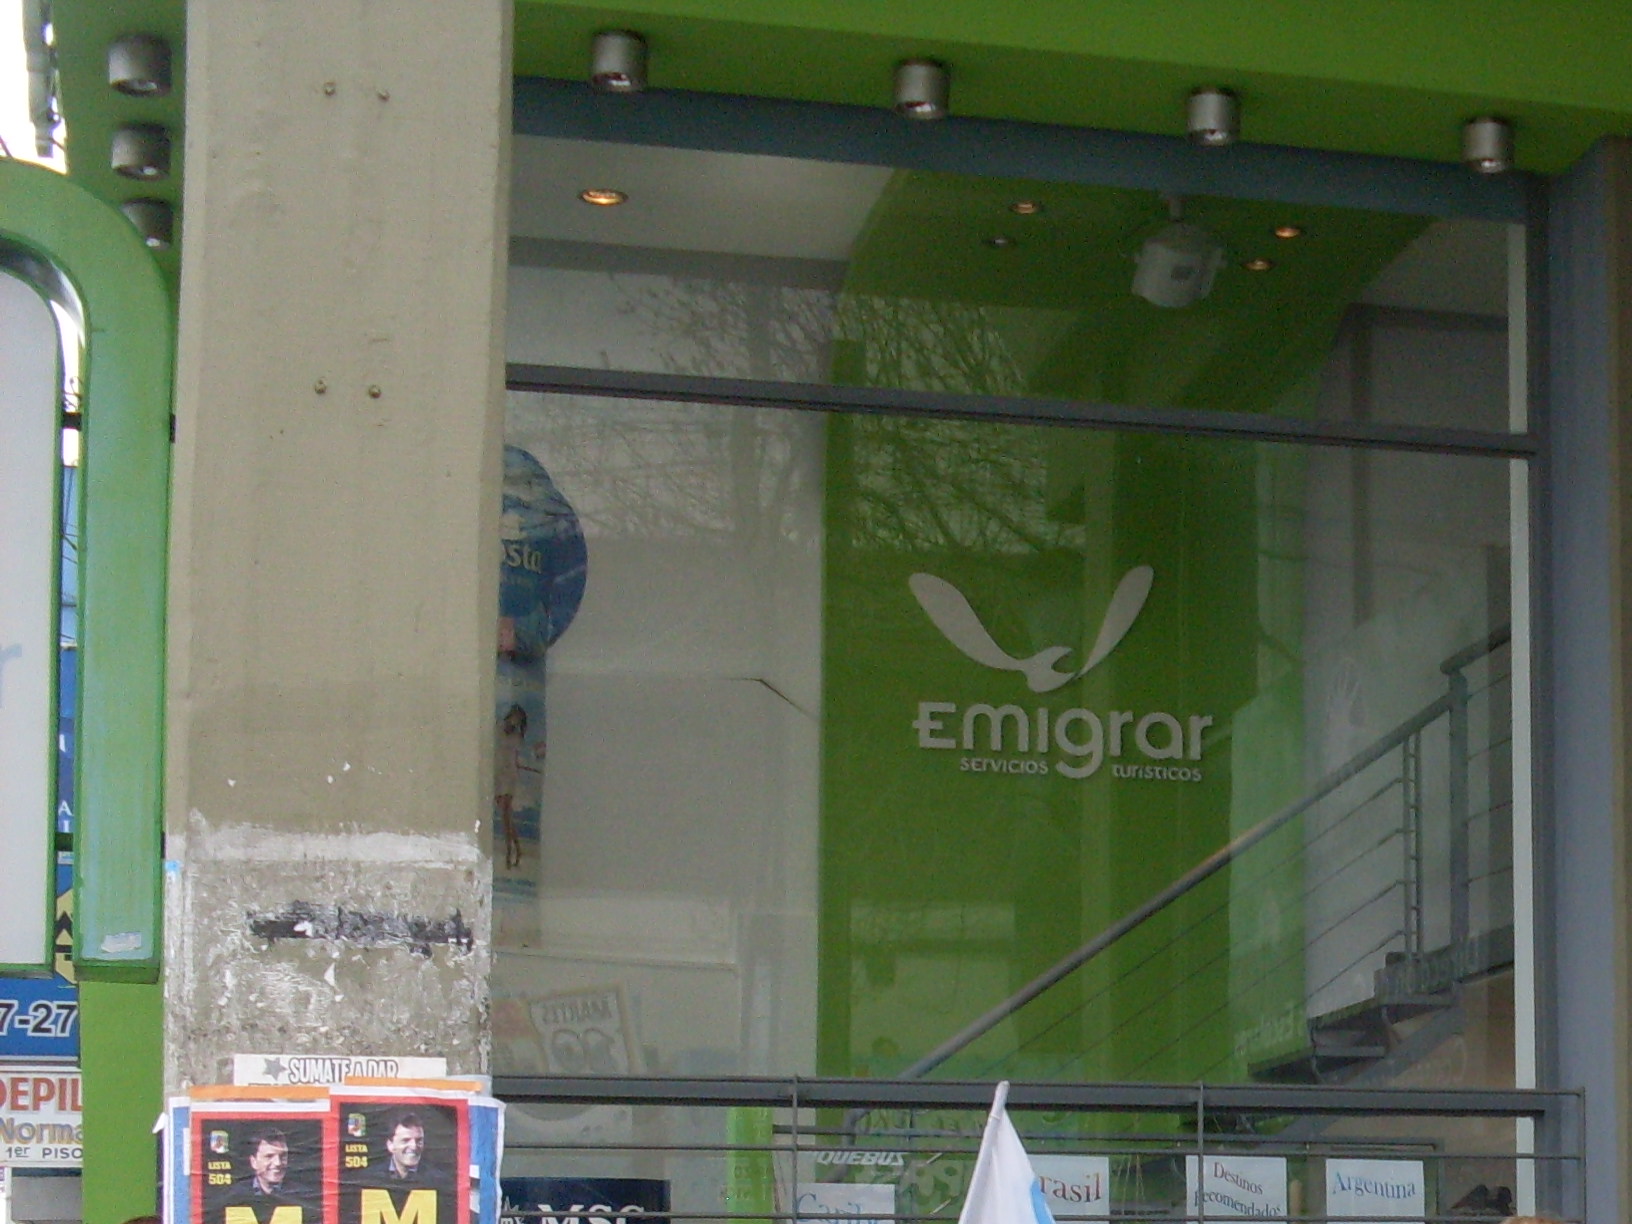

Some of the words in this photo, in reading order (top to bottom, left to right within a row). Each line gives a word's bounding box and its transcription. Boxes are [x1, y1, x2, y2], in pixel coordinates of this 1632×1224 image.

[912, 702, 1213, 779] Emigrar
[288, 1058, 350, 1085] SUMATE
[368, 1059, 399, 1079] DAR
[345, 1144, 368, 1153] LISTA
[345, 1156, 368, 1168] 504
[208, 1161, 231, 1170] LISTA
[208, 1173, 231, 1185] 504
[1213, 1162, 1263, 1195] Destinos
[1039, 1172, 1103, 1204] rasil
[1332, 1171, 1416, 1200] Argentina
